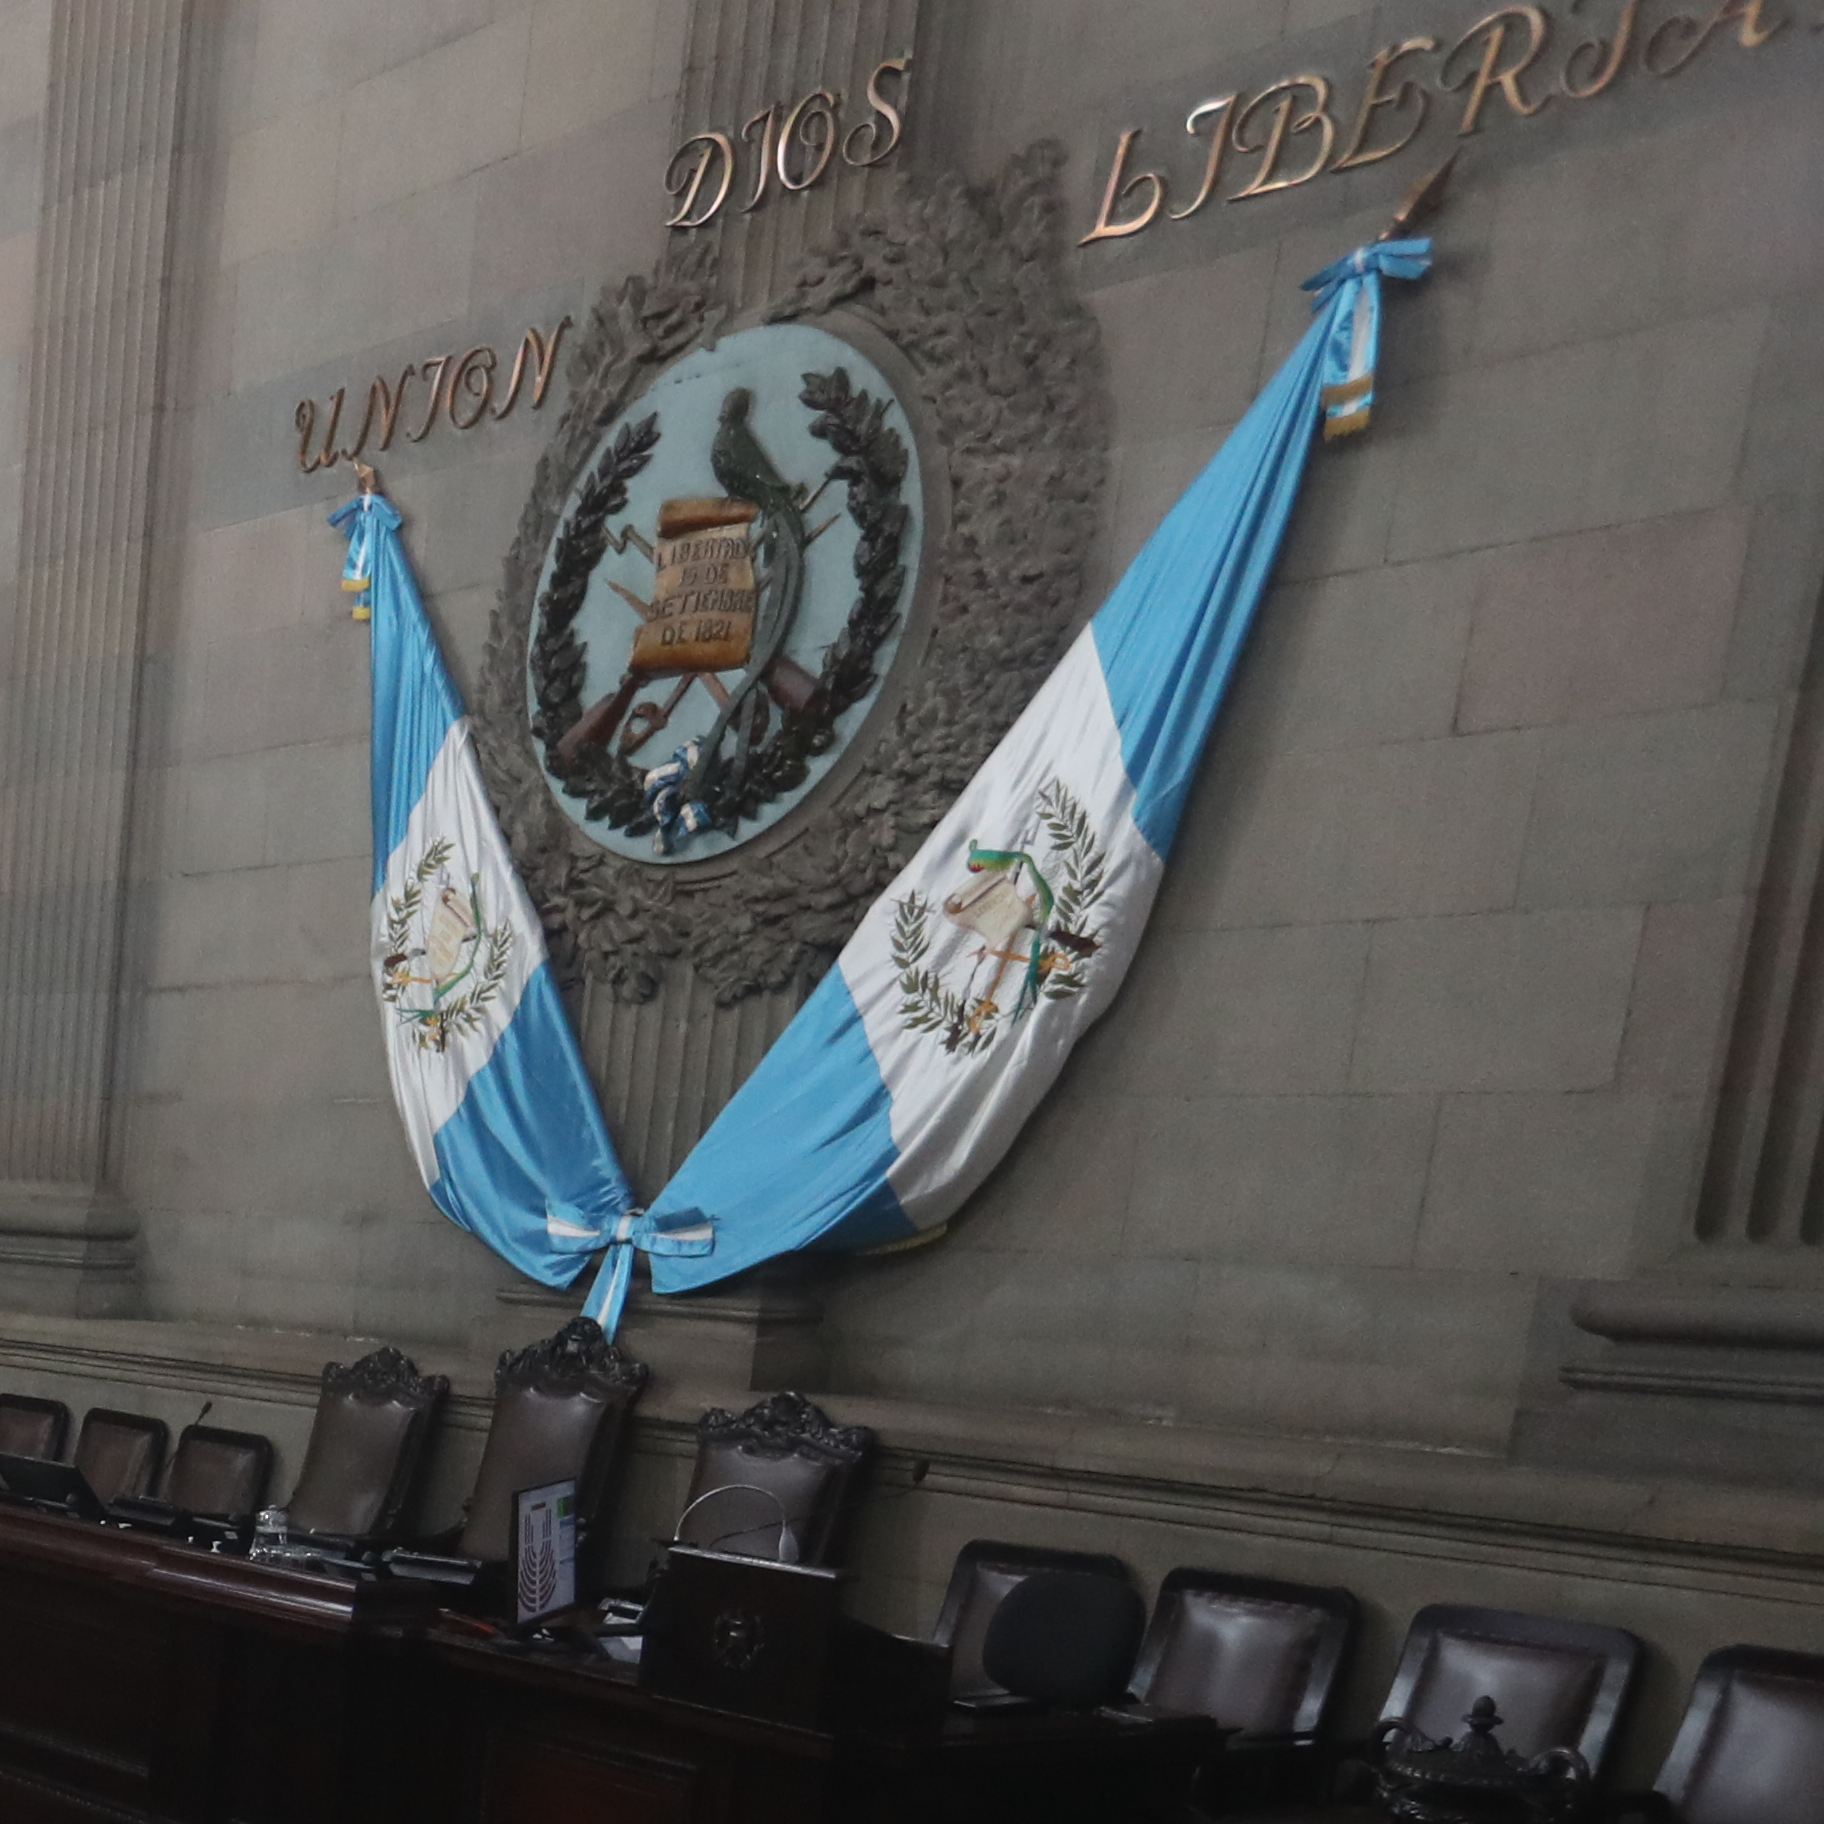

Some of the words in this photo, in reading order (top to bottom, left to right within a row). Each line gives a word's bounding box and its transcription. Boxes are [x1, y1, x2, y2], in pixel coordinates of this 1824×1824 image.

[664, 48, 913, 228] DIOS
[294, 315, 573, 473] UNION
[704, 562, 730, 585] DE
[660, 621, 689, 646] DE
[694, 618, 732, 642] 1821
